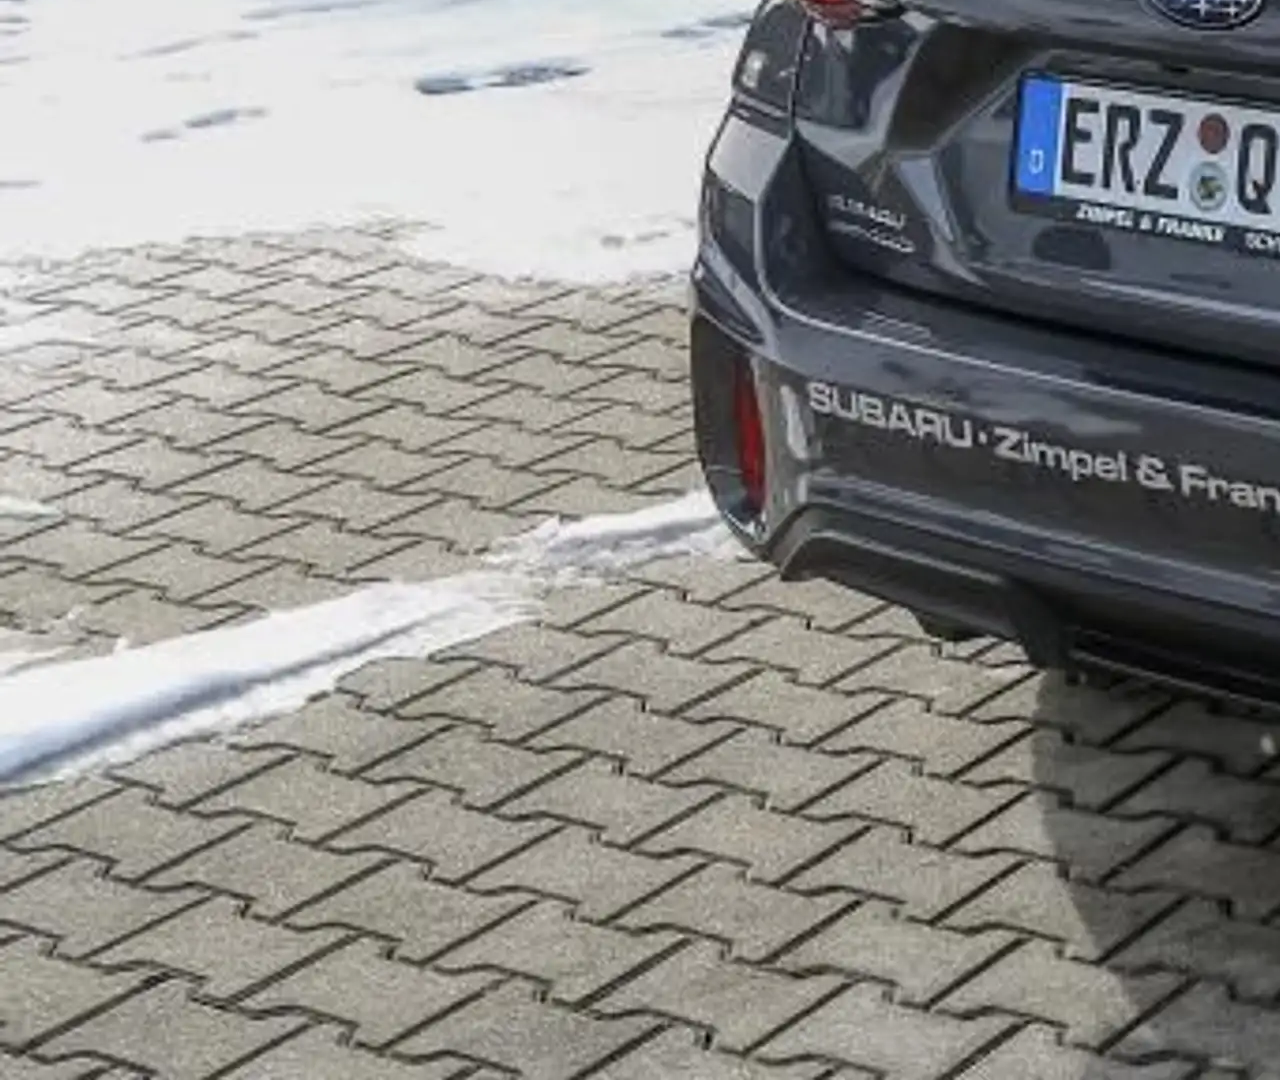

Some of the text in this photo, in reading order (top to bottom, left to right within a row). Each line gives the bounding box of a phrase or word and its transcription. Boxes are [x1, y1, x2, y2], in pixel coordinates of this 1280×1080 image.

[1061, 97, 1188, 200] ERZ
[1236, 122, 1279, 215] Q
[1076, 203, 1133, 229] ZIMPEL
[1155, 216, 1227, 243] FRANKE
[806, 381, 973, 450] SUBARU
[993, 426, 1128, 483] Zimpel
[1135, 456, 1173, 491] &
